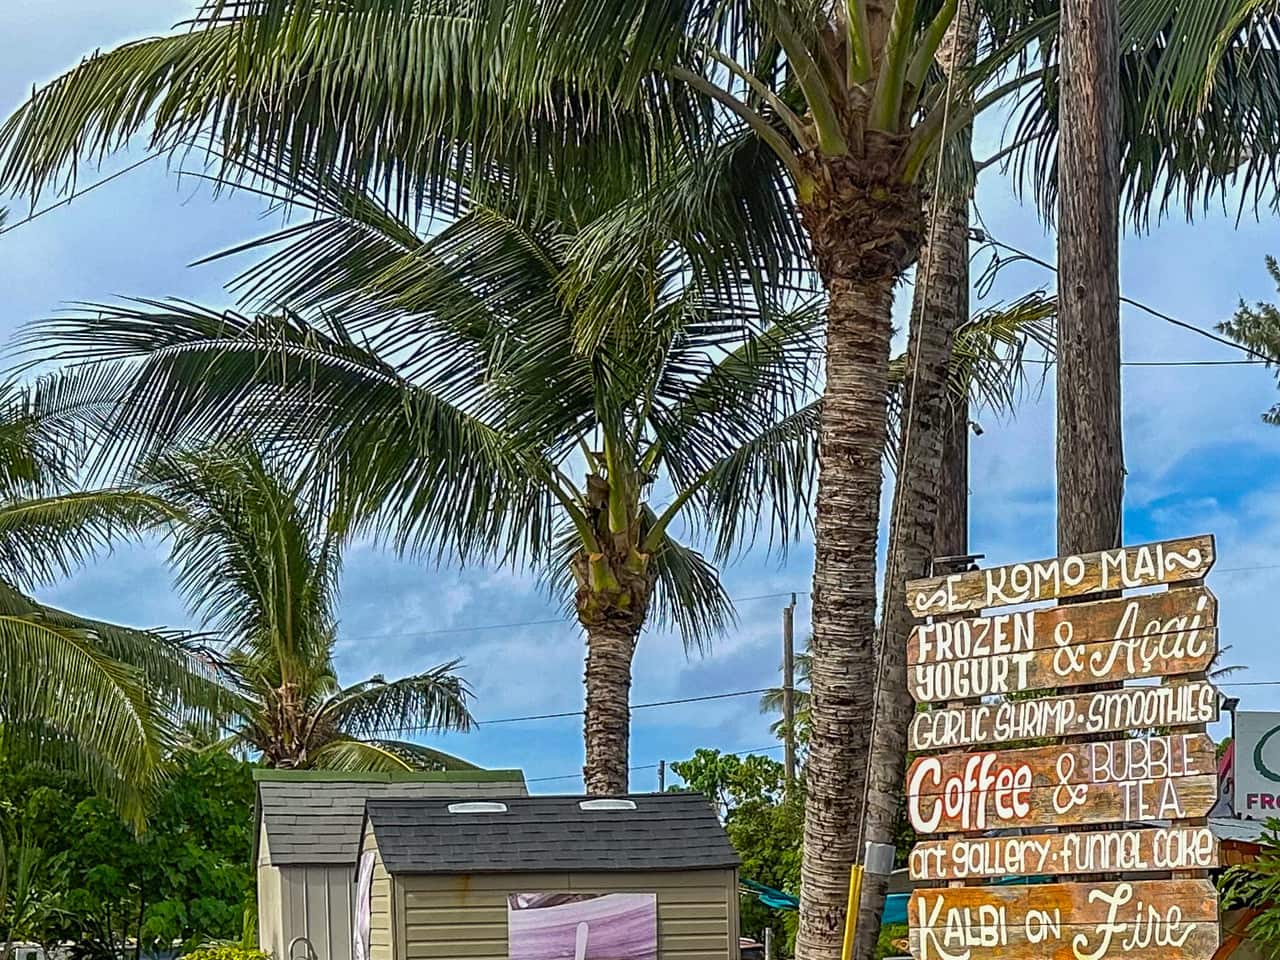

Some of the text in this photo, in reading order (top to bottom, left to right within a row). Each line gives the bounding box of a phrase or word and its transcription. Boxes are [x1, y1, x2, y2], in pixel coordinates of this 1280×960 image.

[947, 545, 1164, 612] E KOMO MAI
[916, 611, 1035, 664] FROZEN
[1053, 621, 1085, 677] &
[915, 652, 1034, 701] YOGURT
[993, 699, 1075, 741] SHRIMP
[1085, 684, 1215, 732] SMOOTHIES
[1090, 733, 1201, 784] BUBBLE
[908, 752, 1088, 834] Coffee &
[1117, 777, 1187, 822] TEA
[910, 843, 947, 880] art
[1153, 828, 1214, 868] cake
[1025, 907, 1061, 944] ON
